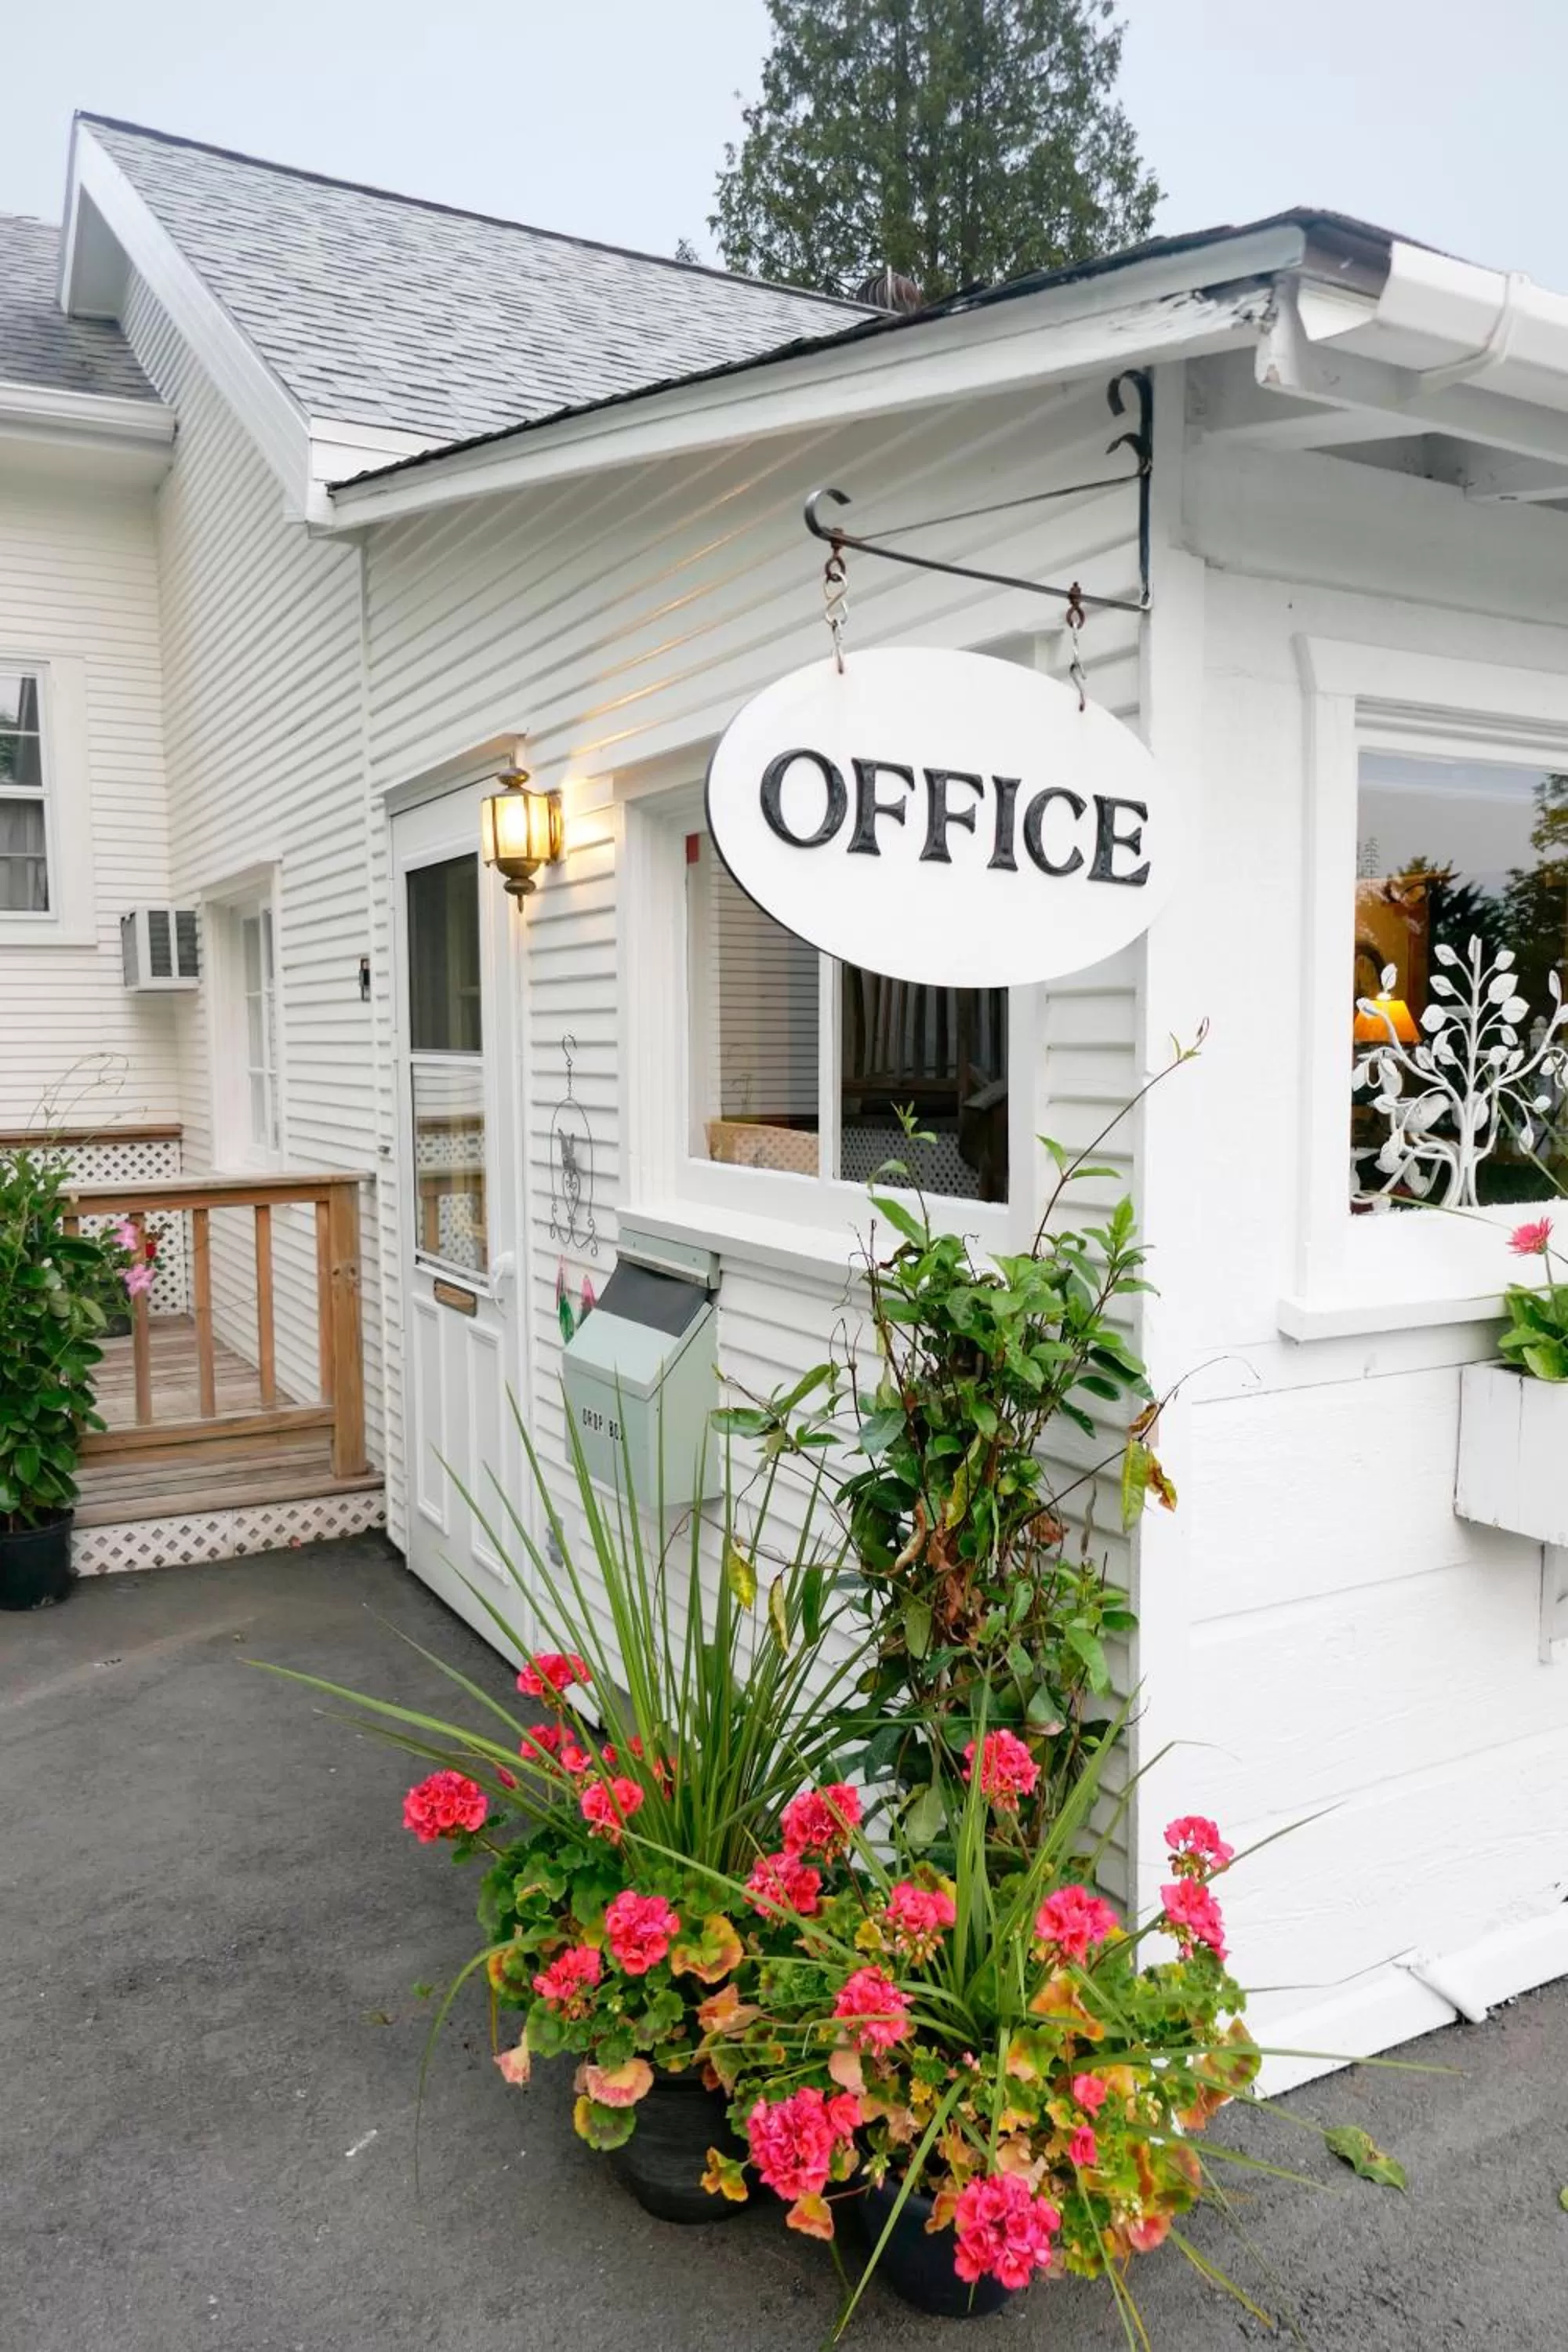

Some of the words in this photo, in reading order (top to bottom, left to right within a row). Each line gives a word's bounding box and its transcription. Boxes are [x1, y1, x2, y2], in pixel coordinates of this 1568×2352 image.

[760, 748, 1151, 887] OFFICE
[583, 1407, 603, 1431] DROP
[609, 1420, 623, 1441] BO
